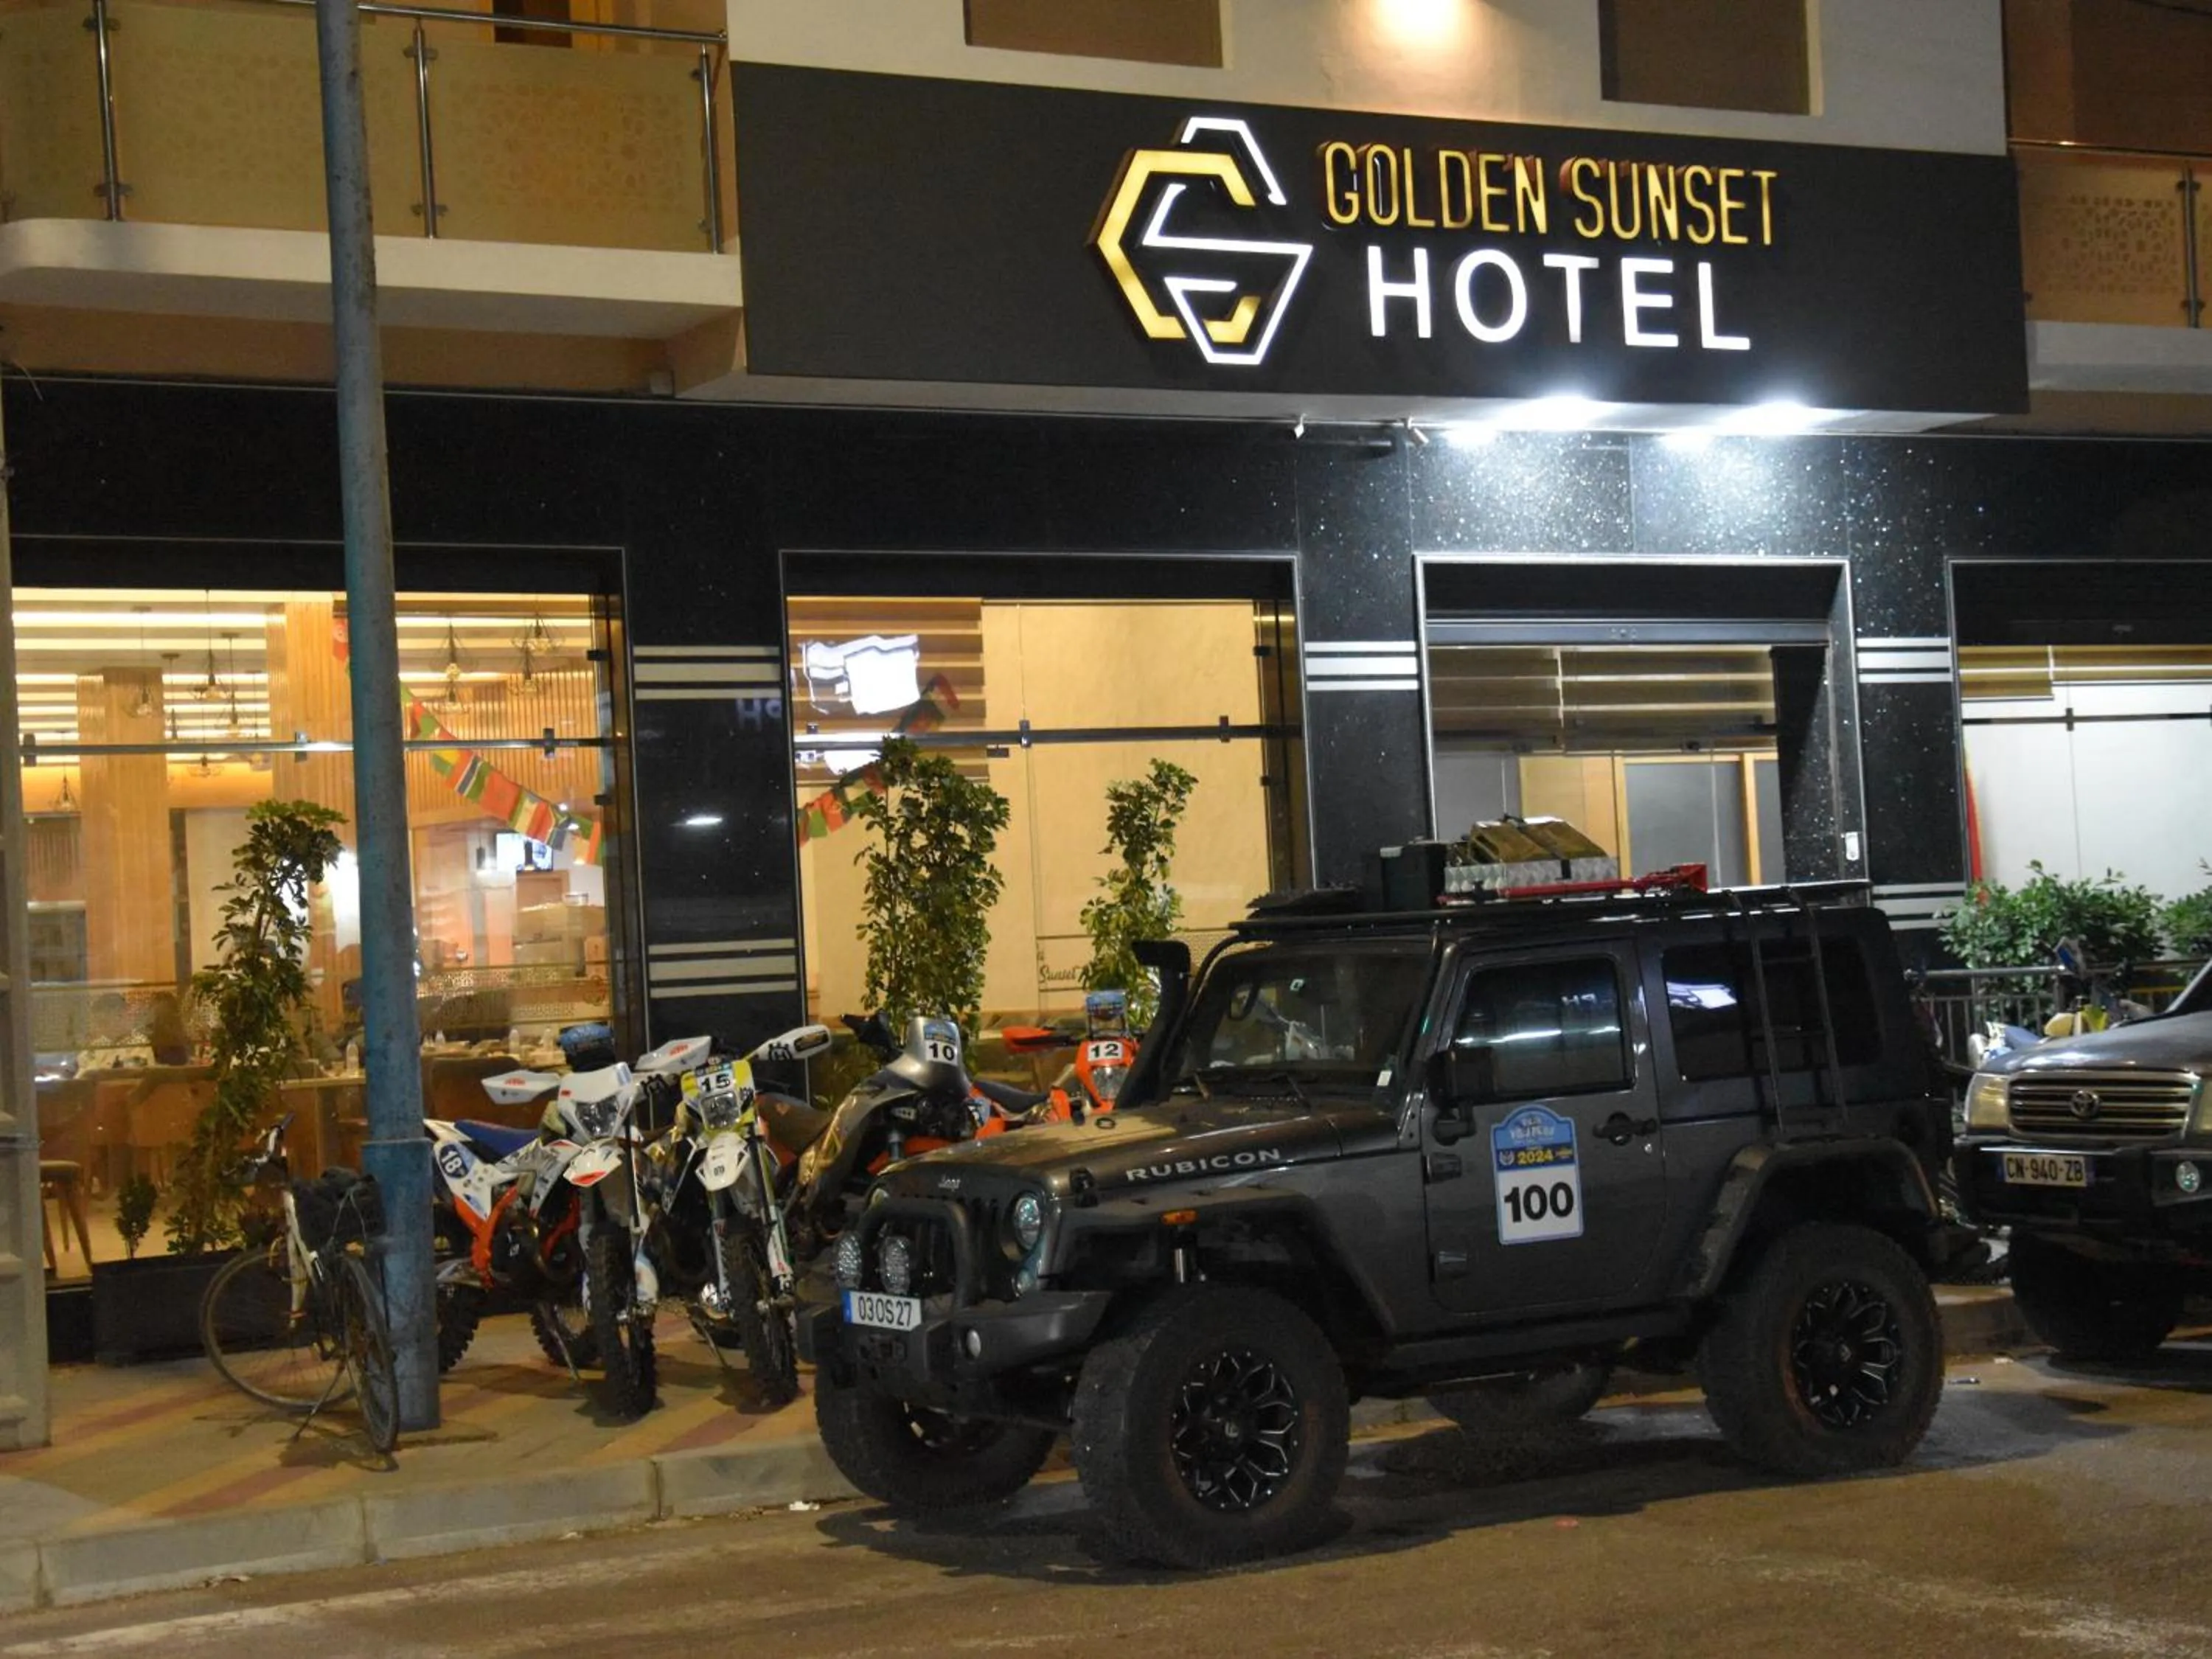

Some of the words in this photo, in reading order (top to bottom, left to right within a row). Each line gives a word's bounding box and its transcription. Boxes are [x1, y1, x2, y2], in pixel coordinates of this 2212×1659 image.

[1324, 141, 1548, 234] GOLDEN
[1568, 156, 1778, 246] SUNSET
[1367, 245, 1752, 351] HOTEL
[928, 1042, 955, 1061] 10
[1091, 1043, 1119, 1058] 12
[700, 1073, 731, 1093] 15
[441, 1150, 463, 1173] 18
[1125, 1147, 1281, 1181] RUBICON
[1517, 1149, 1554, 1166] 2024
[1503, 1181, 1575, 1223] 100
